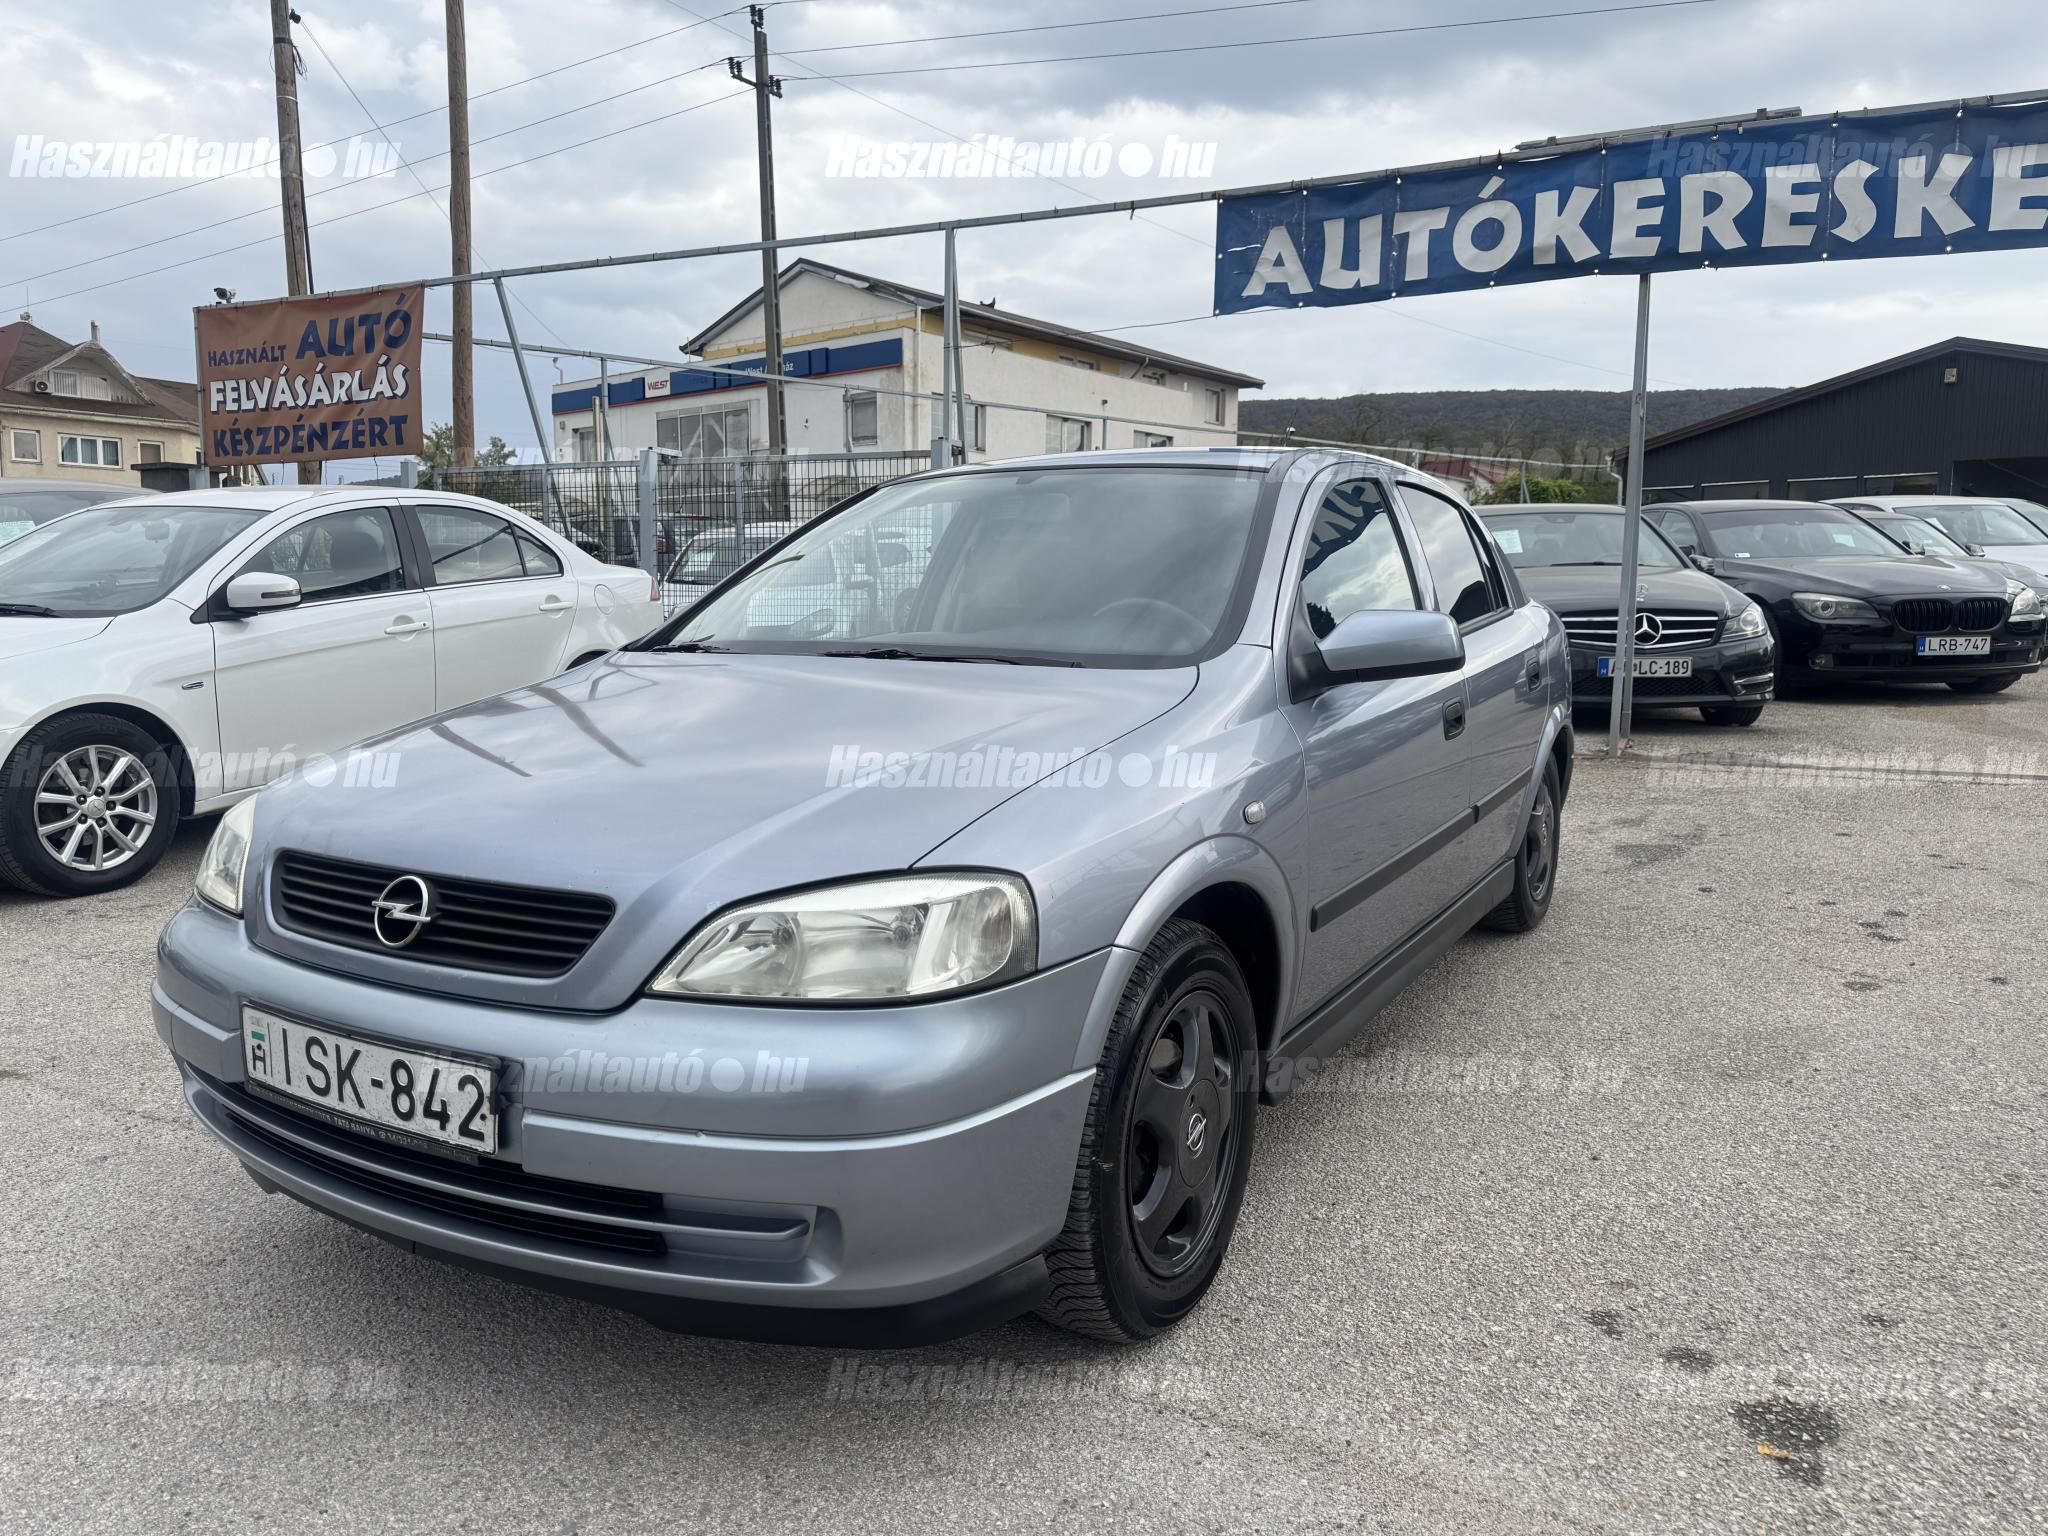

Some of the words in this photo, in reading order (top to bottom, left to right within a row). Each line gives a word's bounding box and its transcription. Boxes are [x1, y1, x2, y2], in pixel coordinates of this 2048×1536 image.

[1241, 143, 2048, 298] AUTÓKERESKE
[208, 341, 287, 367] HASZNÁLT
[296, 293, 412, 359] AUTÓ
[209, 354, 409, 414] FELVÁSÁRLÁS
[647, 379, 670, 392] WEST
[213, 408, 409, 457] KÉSZPÉNZÉRT
[1928, 638, 1988, 651] LRB-747
[252, 1044, 267, 1075] H
[281, 1027, 486, 1142] ISK-842
